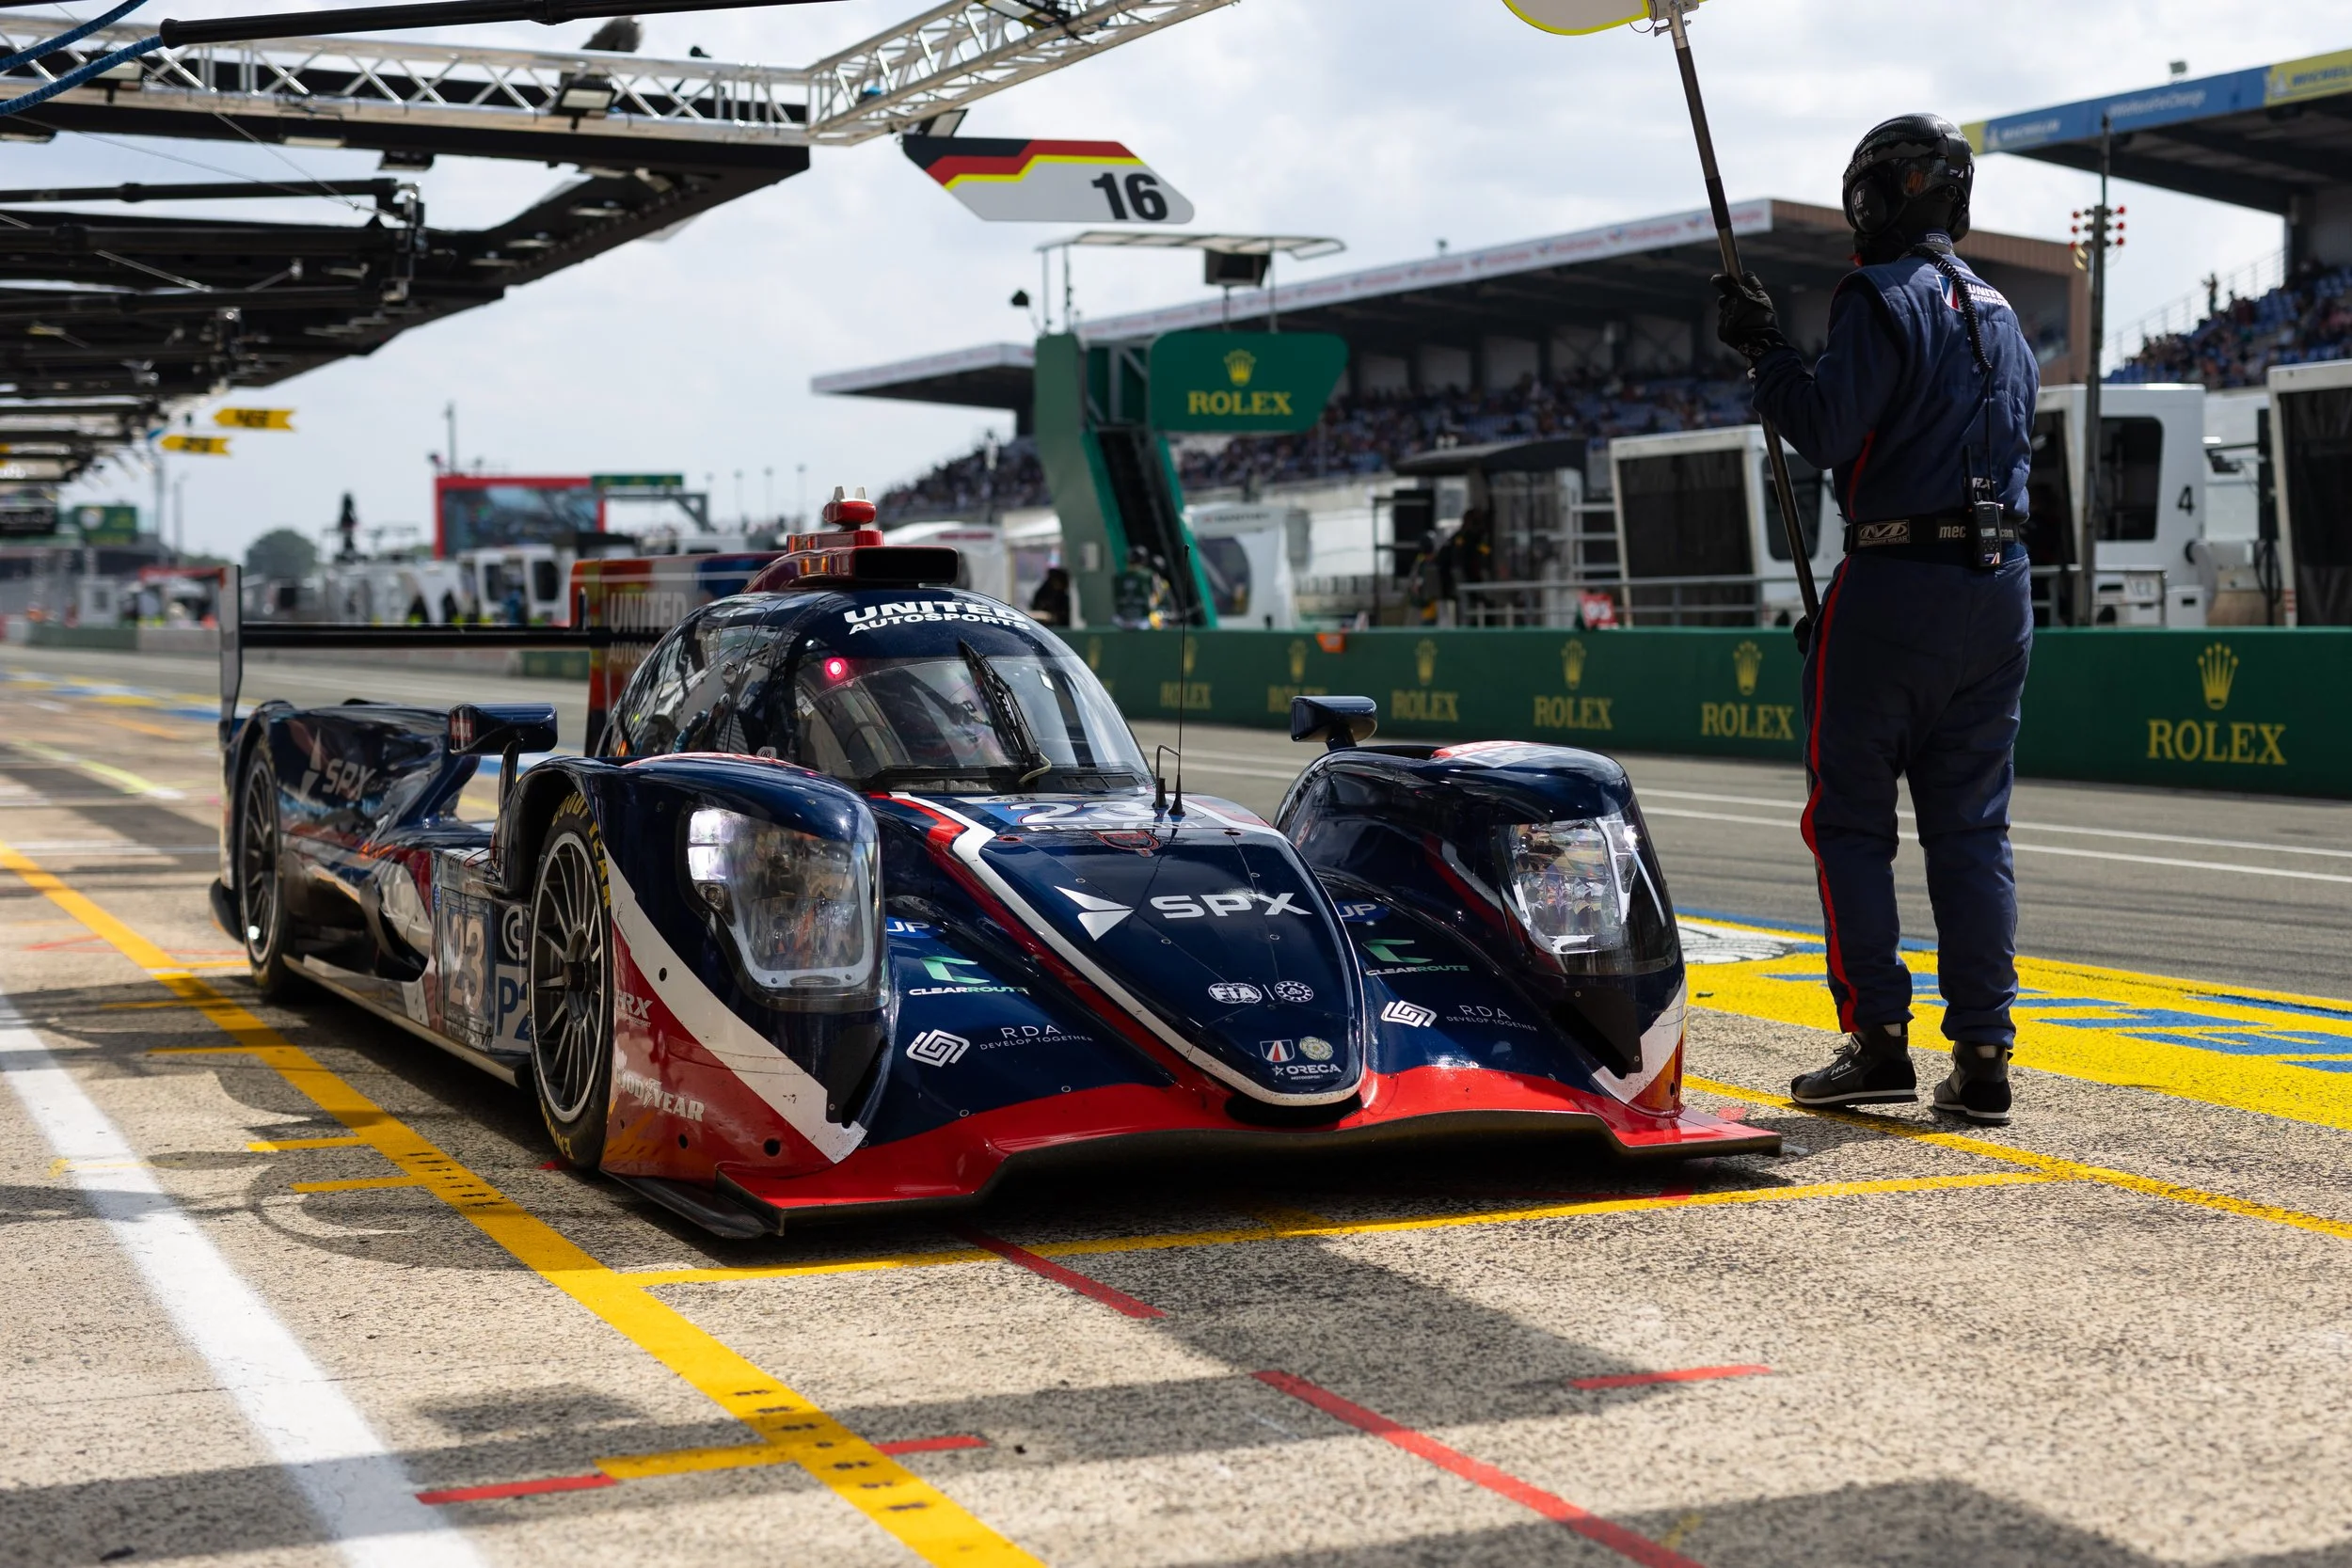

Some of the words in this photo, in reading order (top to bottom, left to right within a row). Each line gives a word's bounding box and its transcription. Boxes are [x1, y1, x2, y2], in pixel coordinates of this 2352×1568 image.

[1091, 172, 1168, 221] 16
[1187, 390, 1294, 416] ROLEX
[2176, 485, 2196, 516] 4
[611, 593, 687, 634] UNITED
[844, 601, 1026, 624] UNITED
[849, 613, 1031, 635] AUTOSPORTS
[1391, 690, 1458, 722] ROLEX
[1534, 696, 1613, 730] ROLEX
[1701, 702, 1794, 741] ROLEX
[2147, 719, 2287, 765] ROLEX
[323, 758, 376, 800] SPX
[1005, 801, 1153, 824] 23
[1150, 893, 1313, 919] SPX
[1366, 964, 1470, 976] CLEARROUTE
[1211, 987, 1259, 1004] FIA
[1445, 1016, 1488, 1024] DEVELOP
[1492, 1019, 1538, 1032] TOGETHER
[1459, 1005, 1511, 1020] RDA
[979, 1038, 1032, 1051] DEVELOP
[1036, 1035, 1093, 1043] TOGETHER
[1001, 1024, 1061, 1038] RDA
[1286, 1064, 1342, 1074] ORECA
